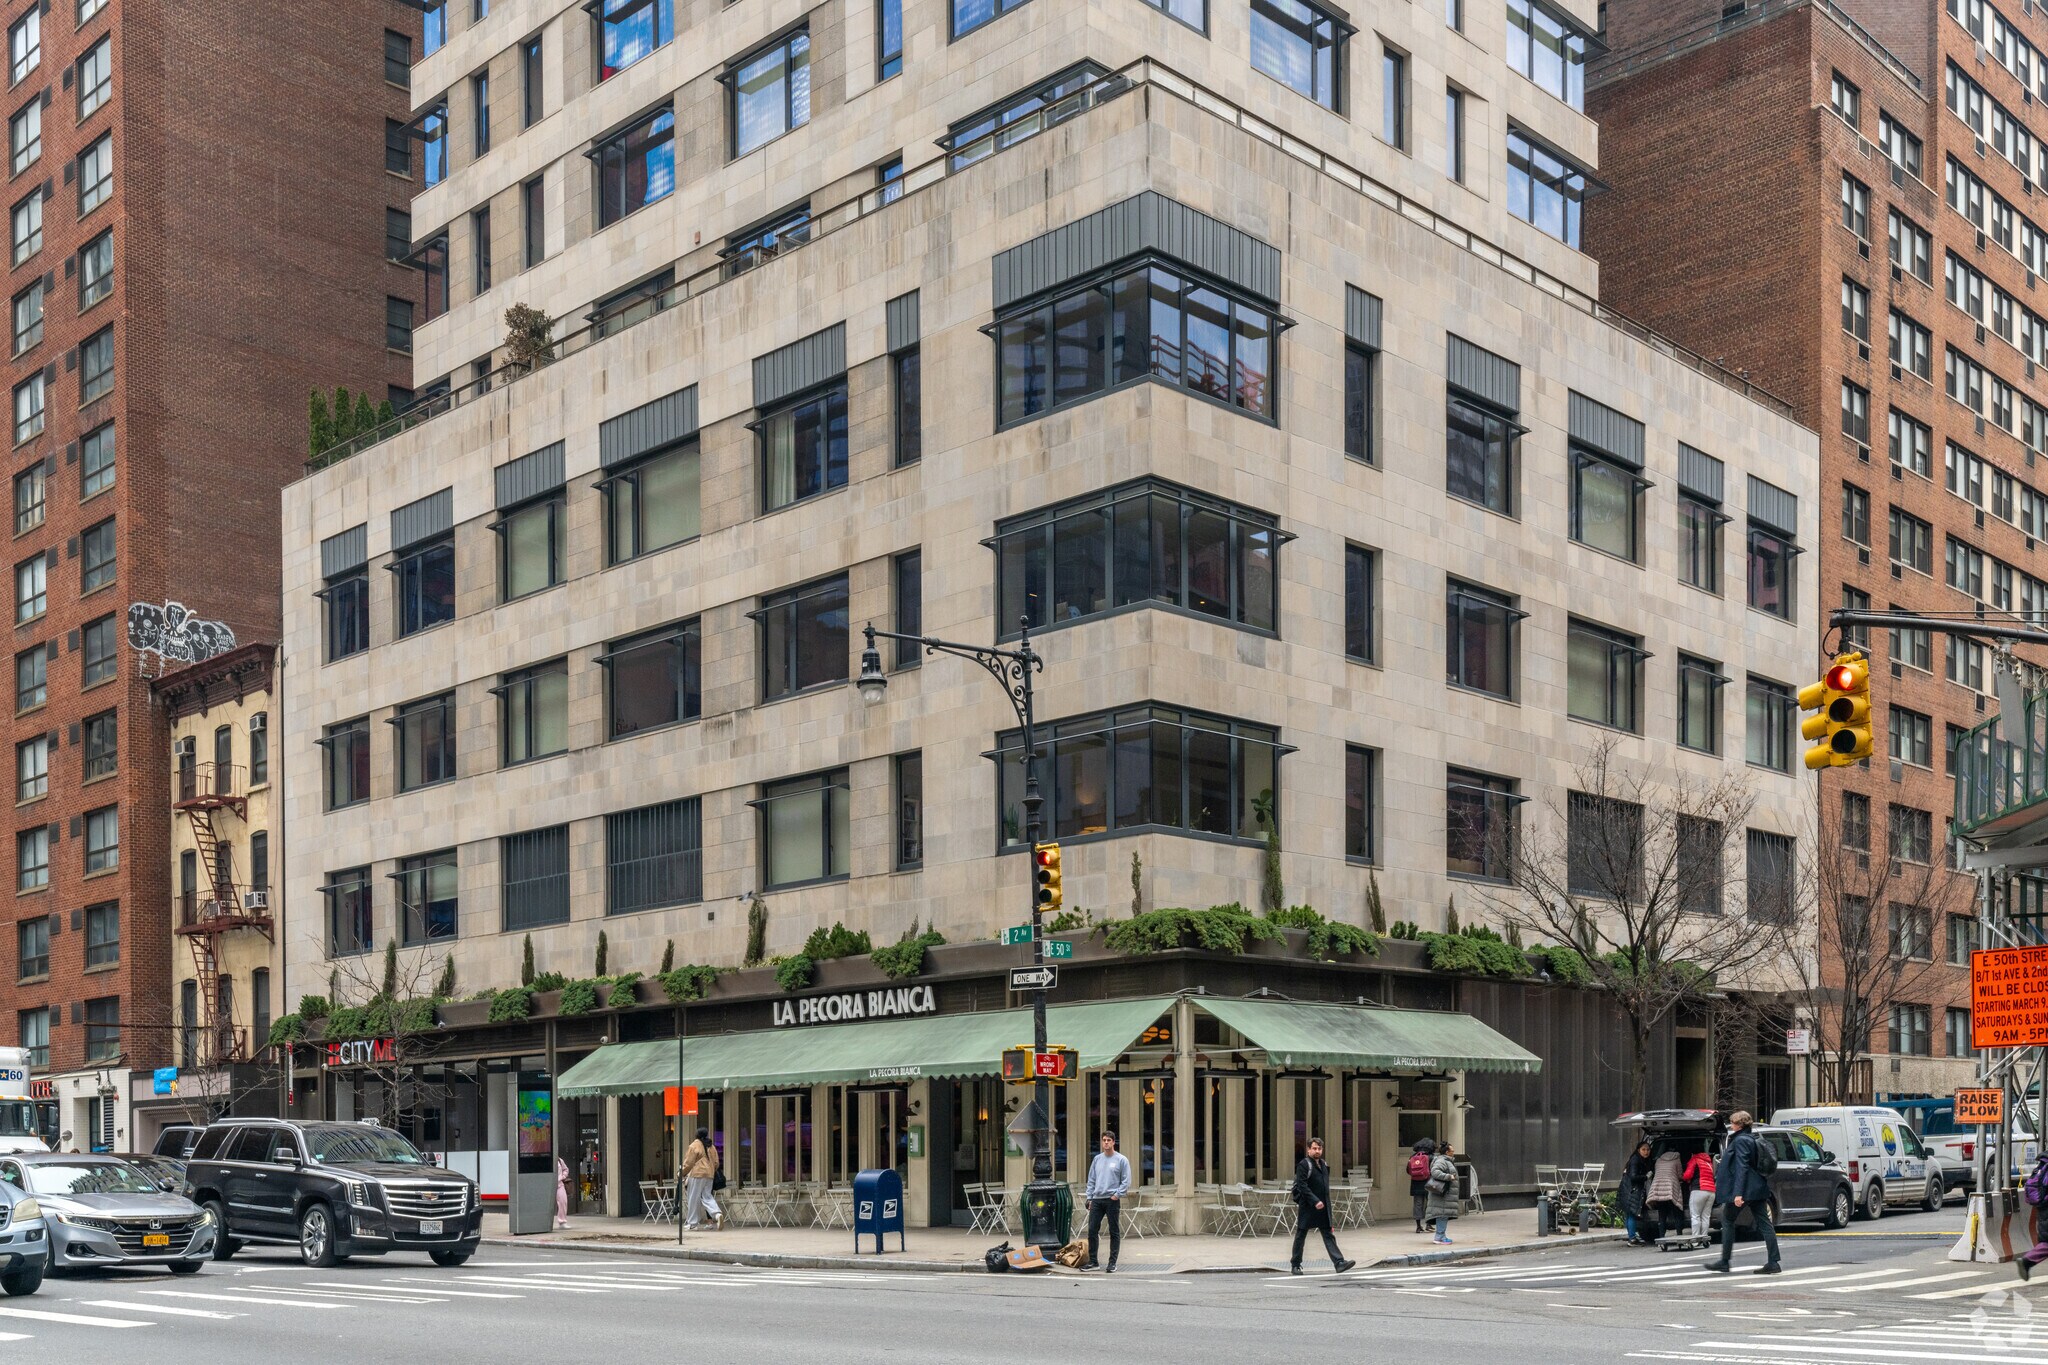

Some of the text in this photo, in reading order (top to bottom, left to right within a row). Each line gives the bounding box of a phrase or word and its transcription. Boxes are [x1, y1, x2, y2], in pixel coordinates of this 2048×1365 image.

[1014, 929, 1019, 941] 2
[1021, 929, 1027, 937] Av
[1050, 943, 1054, 955] E
[1056, 944, 1065, 956] 50
[1065, 944, 1071, 952] St
[1982, 950, 2047, 967] E. 50th STRE
[1016, 973, 1049, 983] ONE WAY
[1976, 970, 1990, 983] B/T
[1992, 970, 2001, 981] 1st
[2004, 968, 2020, 980] AVE
[2023, 967, 2029, 978] &
[1979, 985, 2003, 997] WILL
[2006, 983, 2020, 995] BE
[773, 985, 937, 1026] LA PECORA BIANCA
[1976, 1000, 2011, 1014] STARTING
[2013, 998, 2039, 1010] MARCH
[1976, 1013, 2023, 1028] SATURDAYS
[2025, 1013, 2031, 1025] &
[1994, 1029, 2019, 1042] 9AM
[1393, 1056, 1437, 1067] LA PECORA BIANCA
[9, 1070, 23, 1080] 60
[870, 1066, 921, 1078] LA PECORA BIANCA
[1959, 1093, 1998, 1104] RAISE
[1959, 1105, 1999, 1116] PLOW
